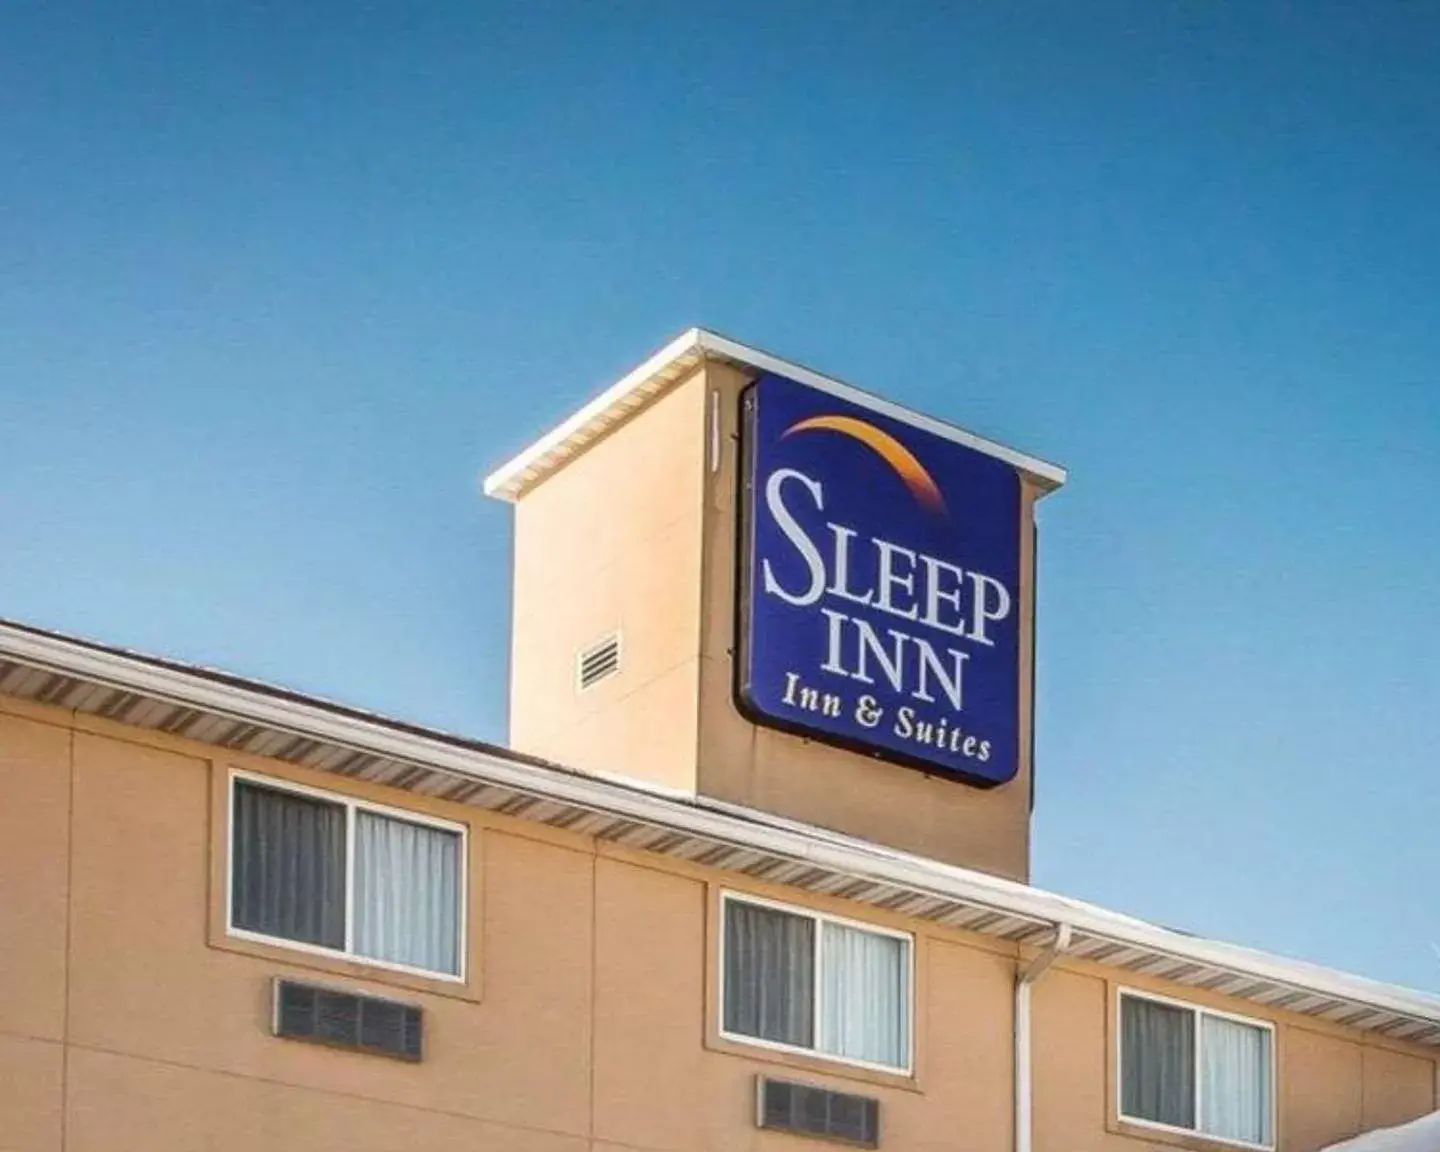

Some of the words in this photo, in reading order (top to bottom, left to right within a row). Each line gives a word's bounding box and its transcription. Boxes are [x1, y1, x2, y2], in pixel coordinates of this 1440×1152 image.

[762, 468, 1010, 646] SLEEP
[820, 608, 969, 711] INN
[782, 672, 841, 717] Inn
[856, 694, 884, 728] &
[894, 707, 992, 762] Suites
